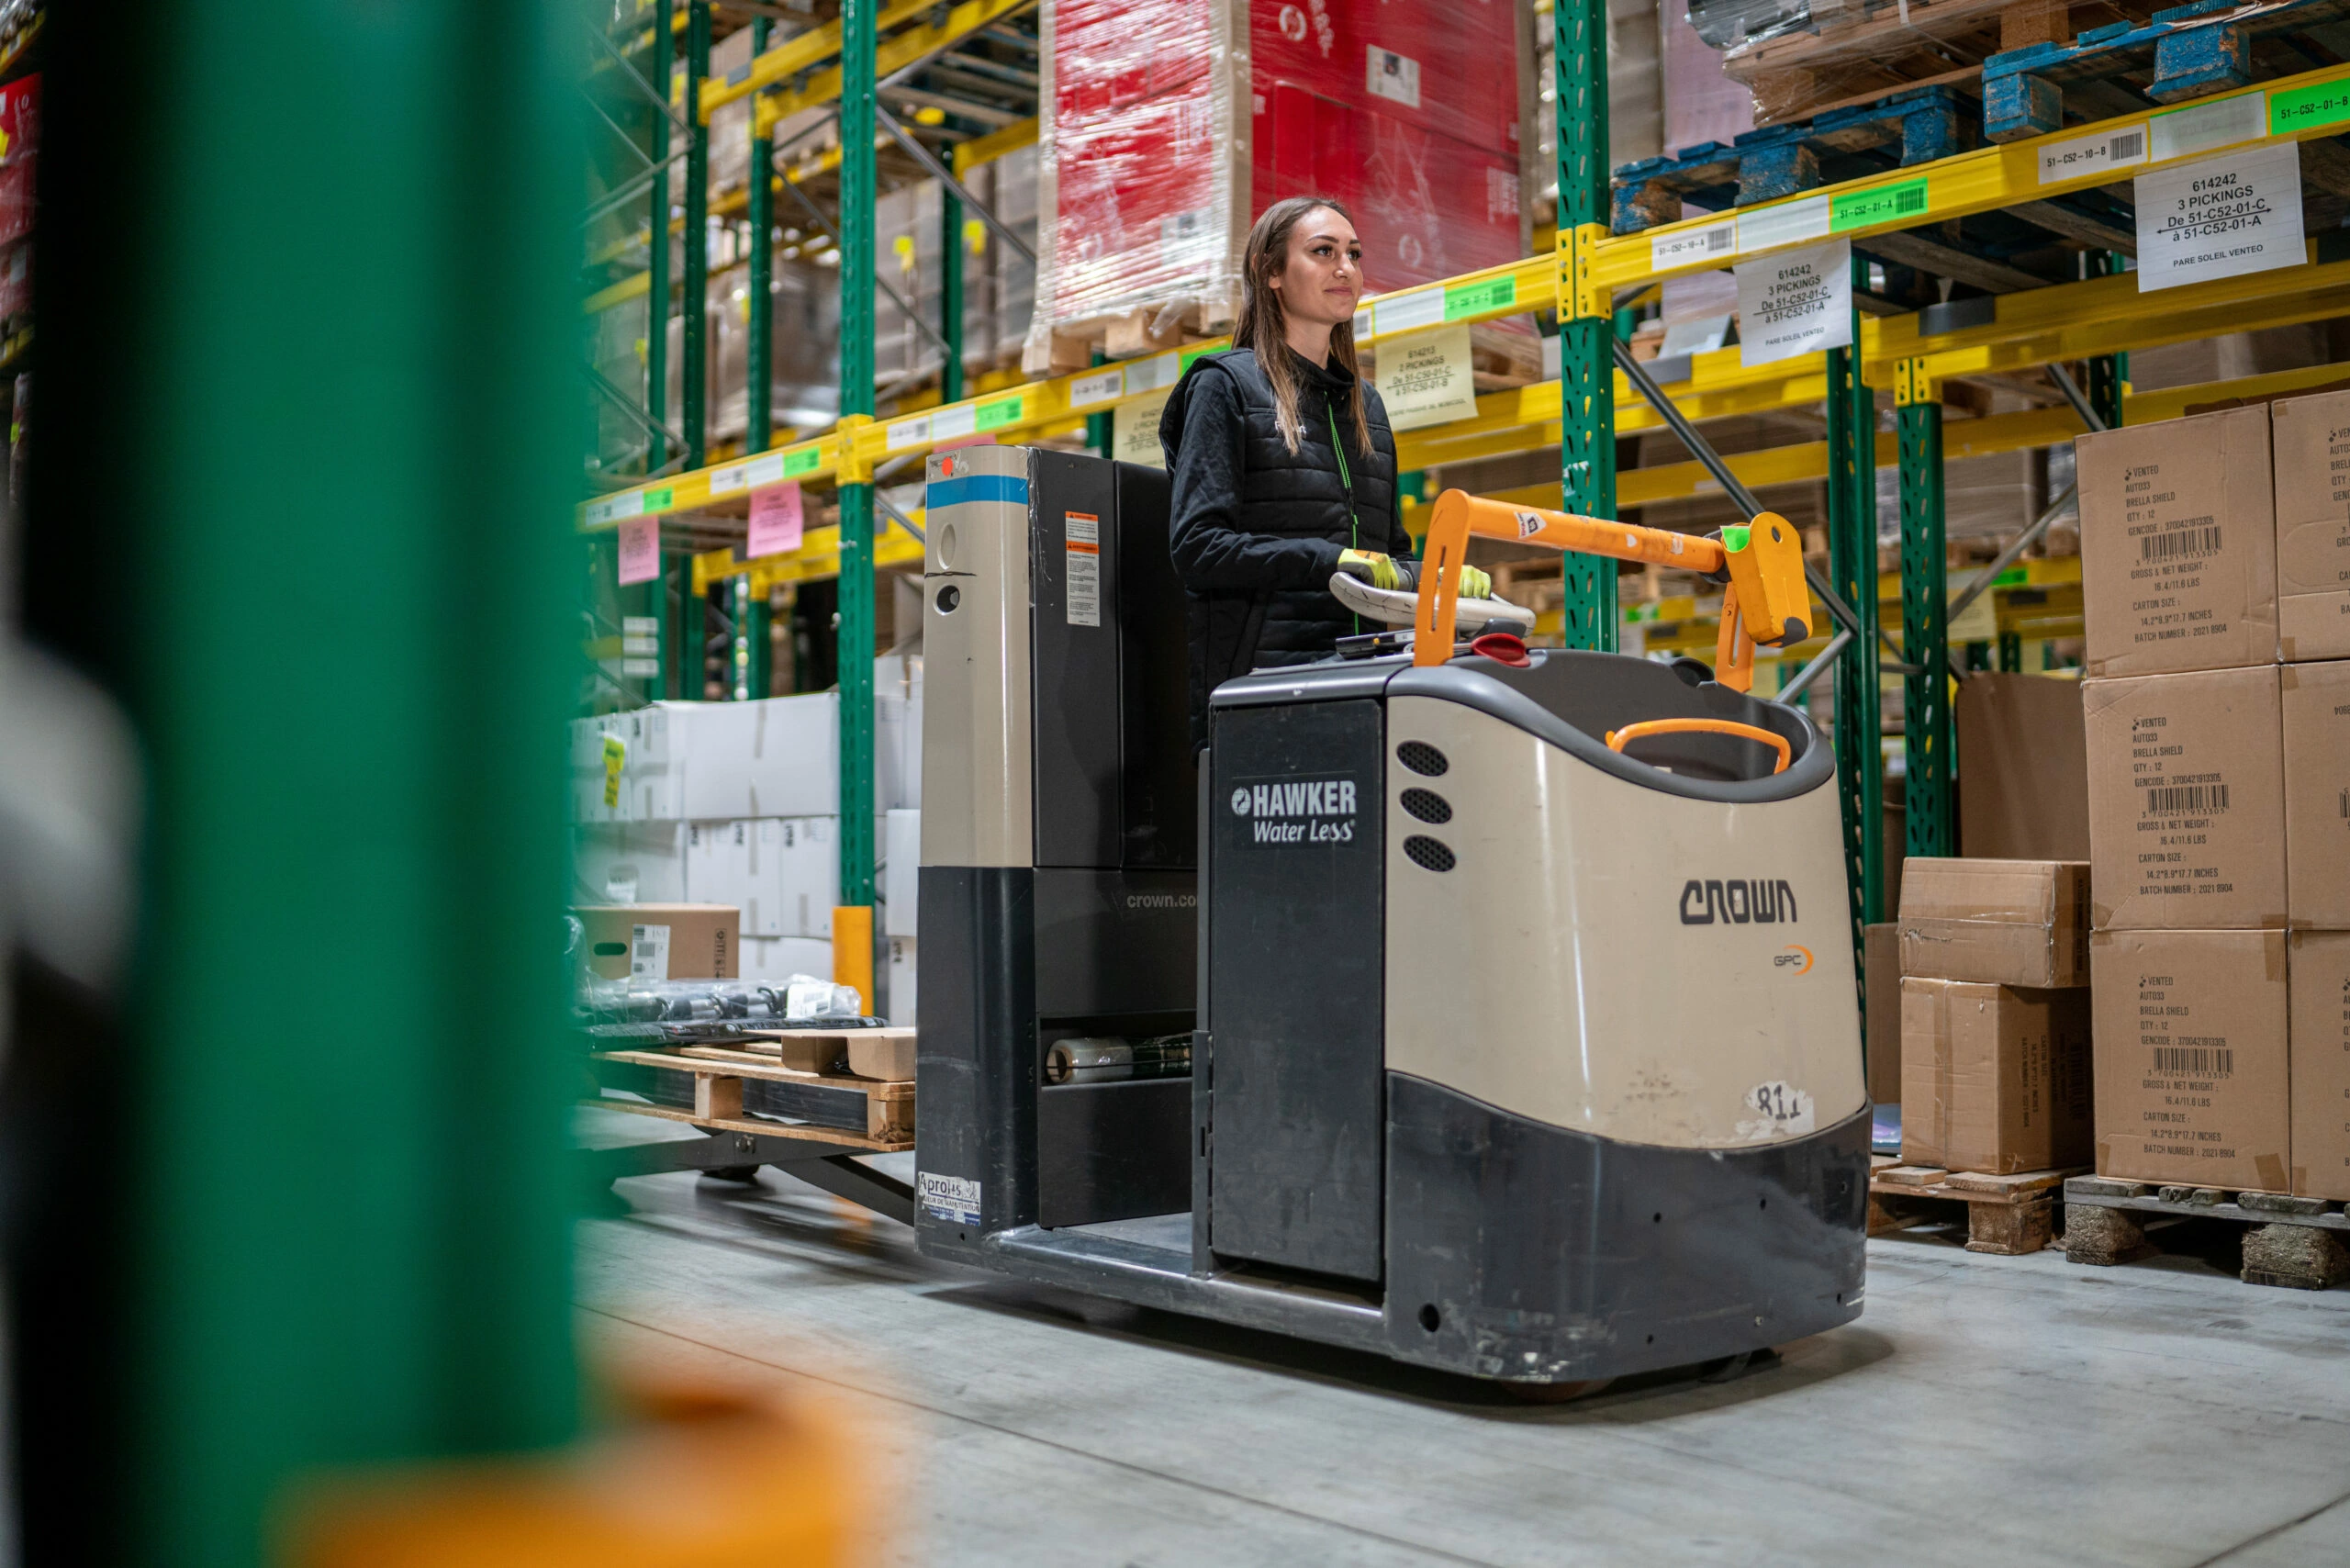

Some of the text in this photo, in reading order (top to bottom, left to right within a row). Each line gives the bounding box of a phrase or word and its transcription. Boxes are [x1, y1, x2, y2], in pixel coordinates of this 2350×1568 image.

[2192, 173, 2237, 193] 614242
[2178, 185, 2254, 210] 3 PICKINGS
[2168, 198, 2266, 228] De 51-C52-01-C
[2173, 215, 2262, 241] à 51-C52-01-A
[2173, 244, 2264, 267] PARE SOLEIL VENTEO
[1778, 263, 1811, 280] 614242
[1768, 275, 1820, 295] 3 PICKINGS
[1762, 286, 1828, 311] De 51-C52-01-C
[1774, 302, 1825, 322] 51-C52-01-A
[1765, 337, 1780, 346] PARE
[1782, 332, 1801, 343] SOLEIL
[2132, 465, 2159, 477] VENTEO
[2126, 491, 2176, 508] BRELLA SHIELD
[2127, 512, 2140, 522] QTY
[2148, 510, 2155, 519] 12
[2128, 523, 2158, 536] GENCODE
[2131, 568, 2153, 580] GROSS
[2162, 565, 2175, 575] NET
[2177, 561, 2203, 573] WEIGHT
[2187, 577, 2200, 588] LBS
[2132, 599, 2159, 611] CARTON
[2161, 598, 2176, 608] SIZE
[2188, 610, 2212, 622] INCHES
[2134, 632, 2156, 643] BATCH
[2158, 628, 2186, 640] NUMBER
[2193, 626, 2209, 636] 2021
[2141, 717, 2166, 728] VENTEO
[2133, 745, 2183, 757] BRELLA SHIELD
[2133, 763, 2147, 773] QTY
[2154, 762, 2162, 771] 12
[2134, 777, 2165, 788] GENCODE
[1253, 780, 1357, 817] HAWKER
[2137, 821, 2159, 831] GROSS
[2168, 820, 2181, 829] NET
[2184, 819, 2210, 829] WEIGHT
[1254, 821, 1305, 843] Water
[2193, 834, 2207, 844] LBS
[2138, 853, 2165, 863] CARTON
[2166, 852, 2181, 862] SIZE
[2194, 868, 2218, 878] INCHES
[2140, 886, 2162, 895] BATCH
[2164, 885, 2191, 894] NUMBER
[2199, 884, 2215, 894] 2021
[1679, 879, 1797, 925] CROWN
[1774, 955, 1801, 967] GPC
[2148, 977, 2173, 986] VENTEO
[2140, 1006, 2189, 1016] BRELLA SHIELD
[2141, 1021, 2154, 1030] QTY
[2161, 1022, 2168, 1030] 12
[2141, 1036, 2170, 1045] GENCODE
[2143, 1080, 2165, 1089] GROSS
[2174, 1081, 2186, 1091] NET
[2188, 1081, 2213, 1092] WEIGHT
[2198, 1098, 2210, 1107] LBS
[2143, 1112, 2169, 1122] CARTON
[2171, 1113, 2186, 1123] SIZE
[2198, 1131, 2221, 1142] INCHES
[2143, 1144, 2165, 1154] BATCH
[2167, 1145, 2194, 1156] NUMBER
[2201, 1148, 2218, 1158] 2021
